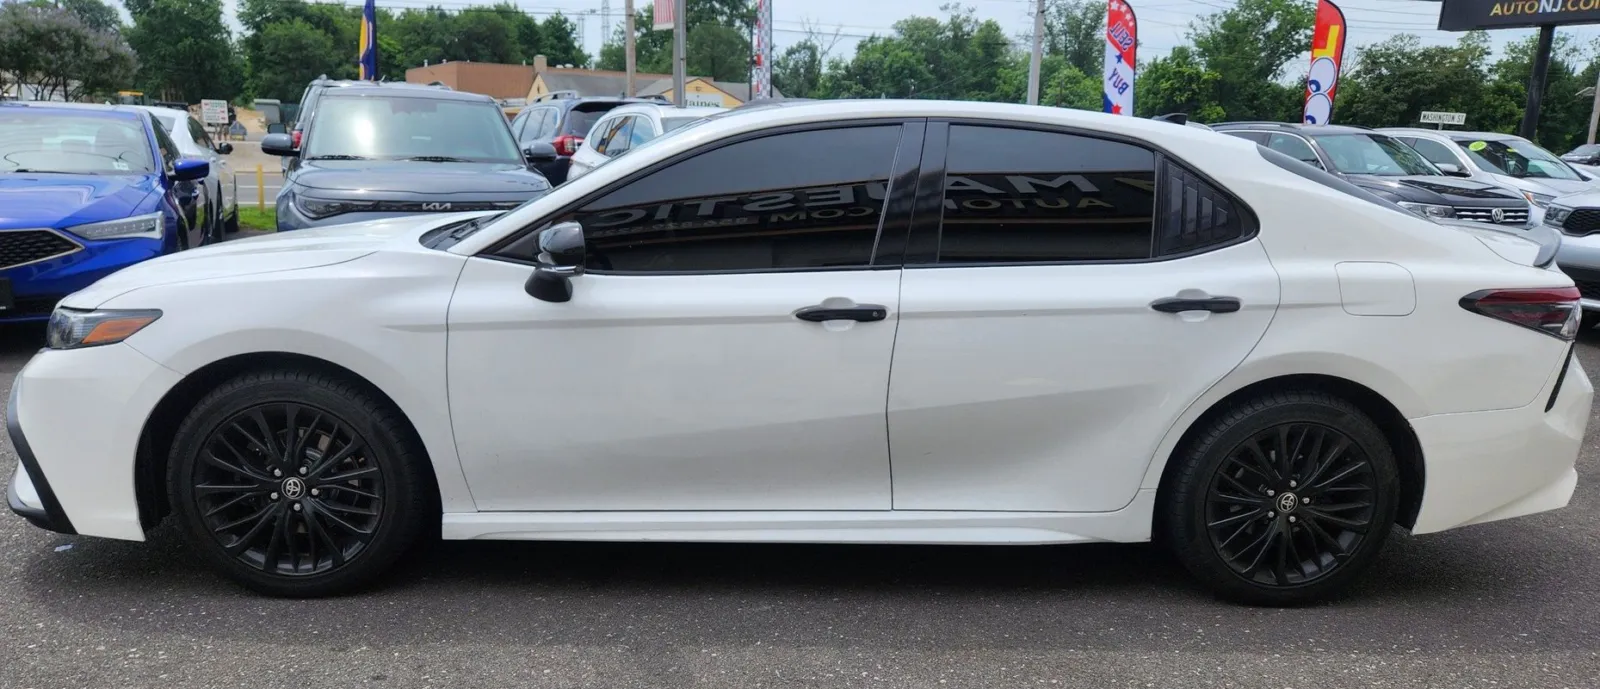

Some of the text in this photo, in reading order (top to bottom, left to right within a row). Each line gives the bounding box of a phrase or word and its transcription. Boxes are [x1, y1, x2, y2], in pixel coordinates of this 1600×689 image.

[1422, 113, 1465, 123] WASHINGTON ST
[422, 202, 451, 210] KIA
